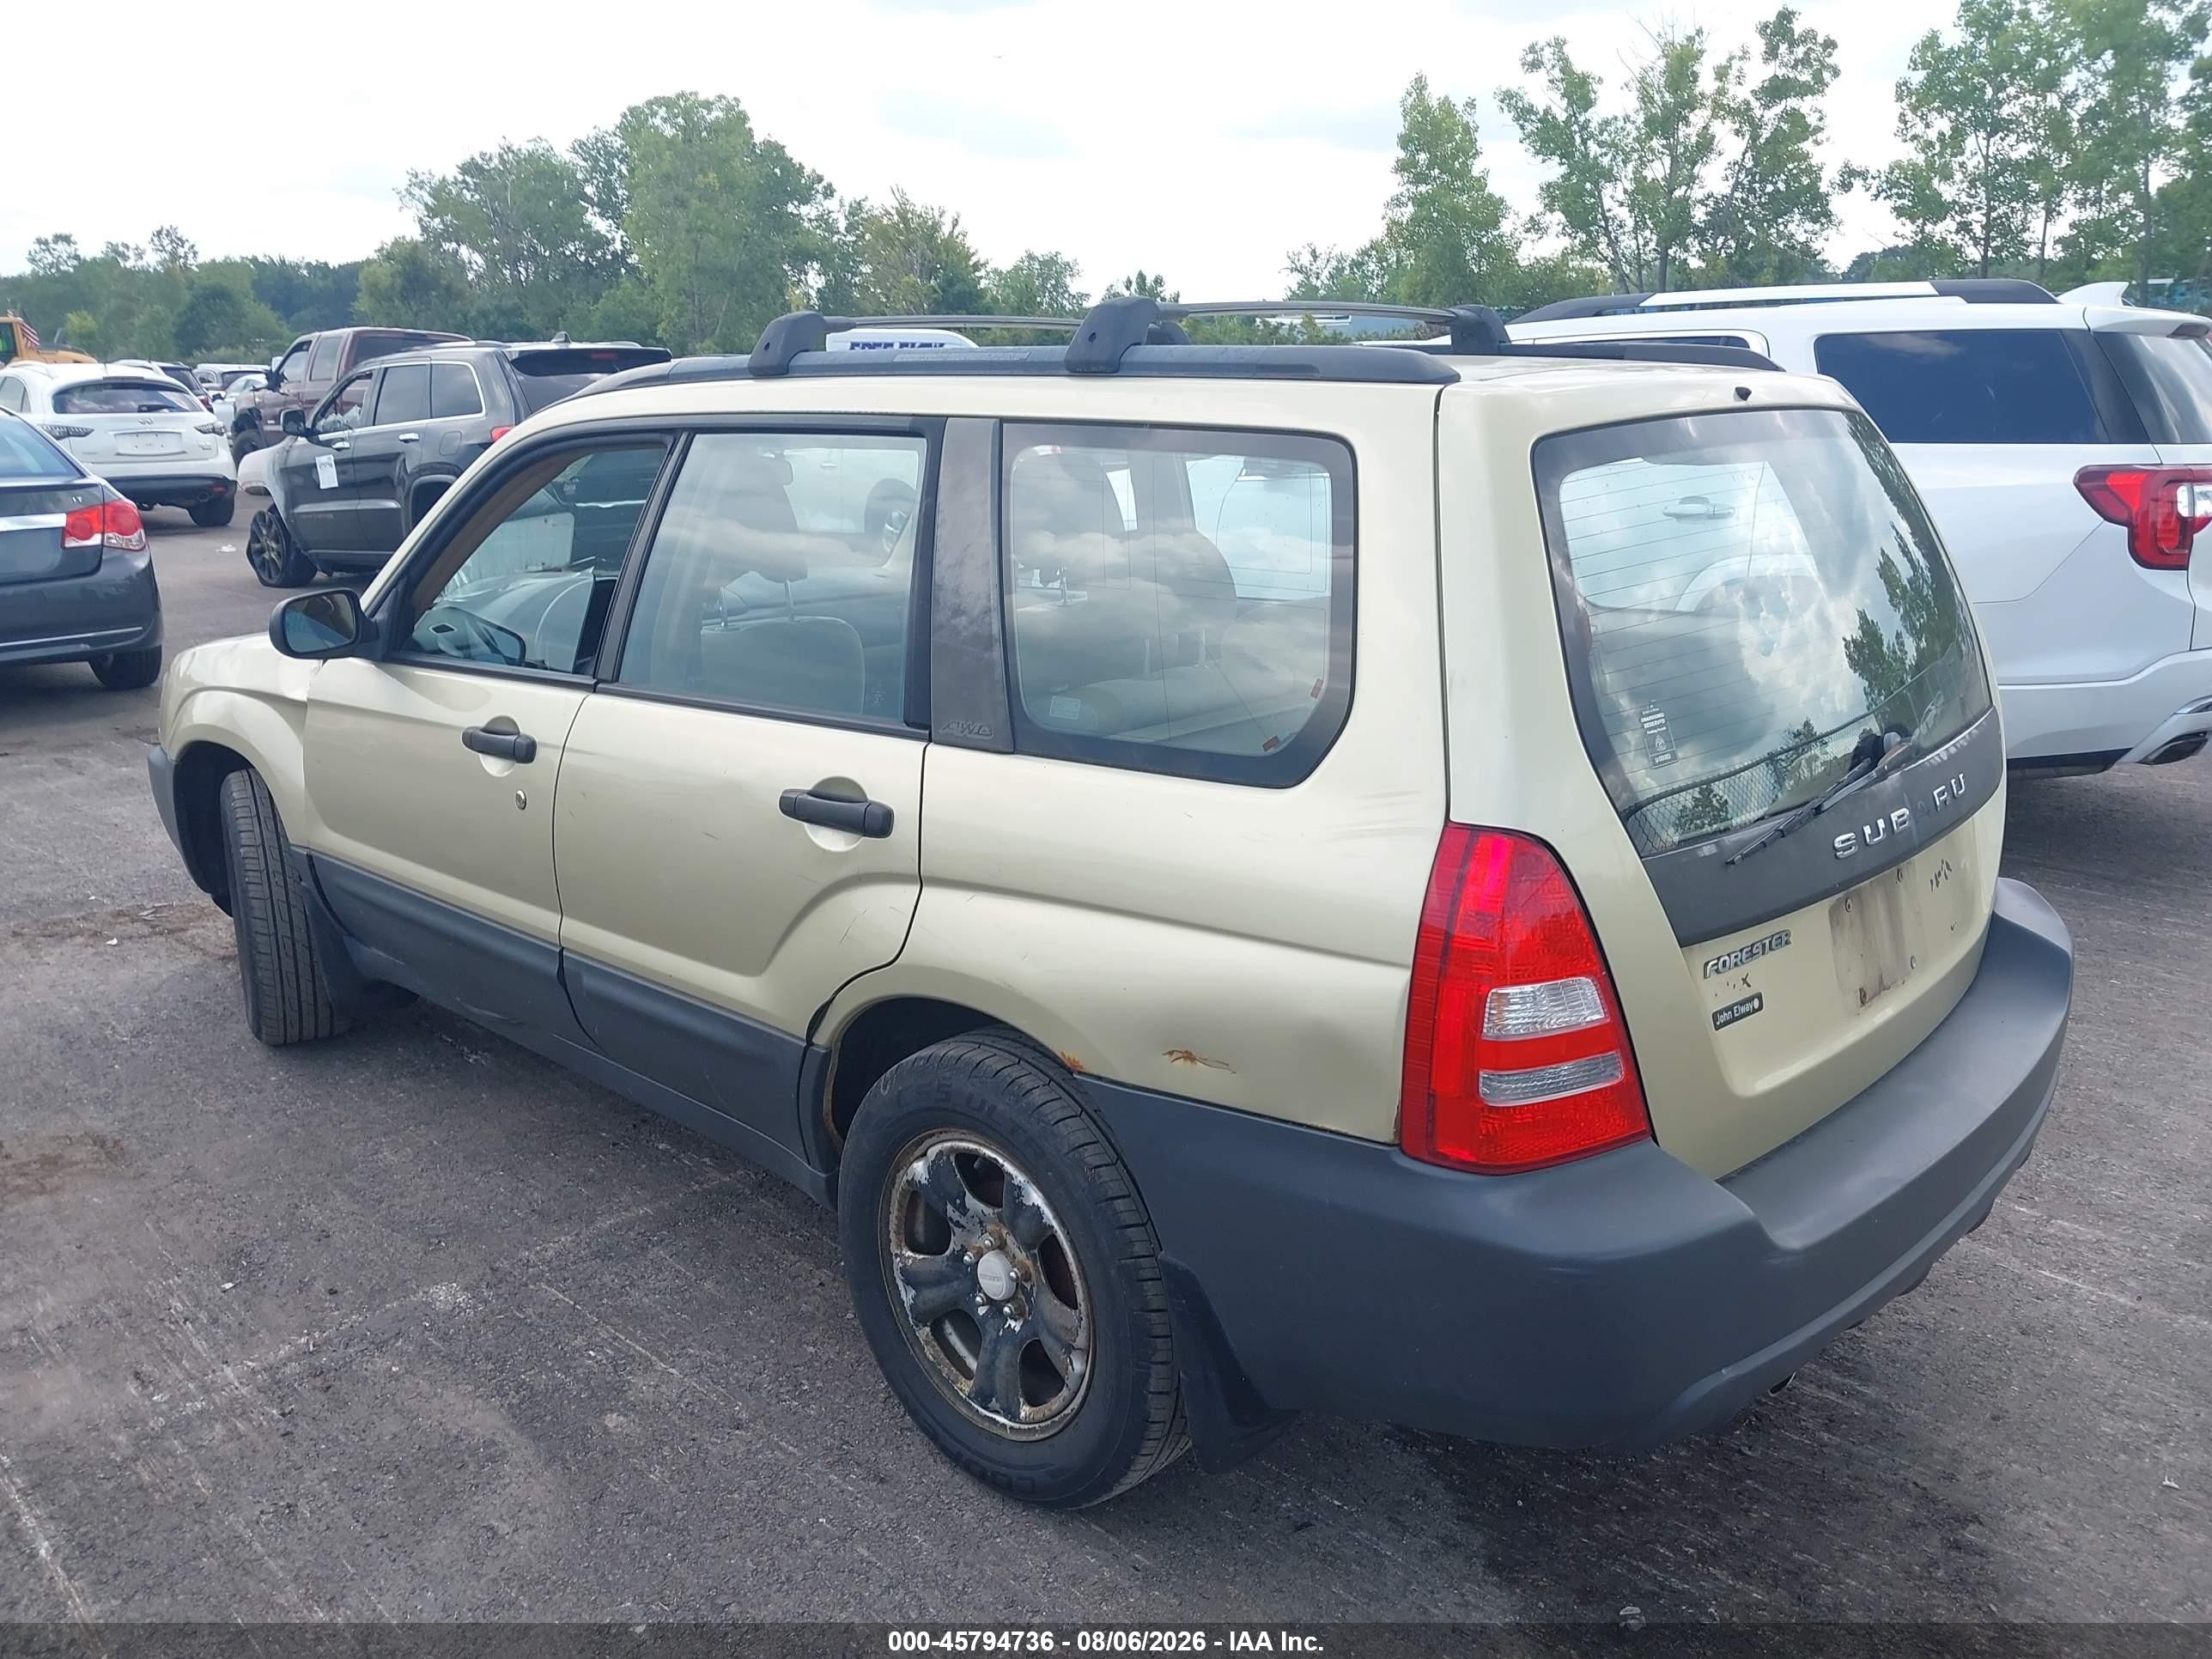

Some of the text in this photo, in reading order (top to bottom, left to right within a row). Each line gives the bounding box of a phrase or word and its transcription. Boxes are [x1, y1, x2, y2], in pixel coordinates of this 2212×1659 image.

[1704, 929, 1791, 979] FORESTER
[1716, 1000, 1753, 1025] John Elway
